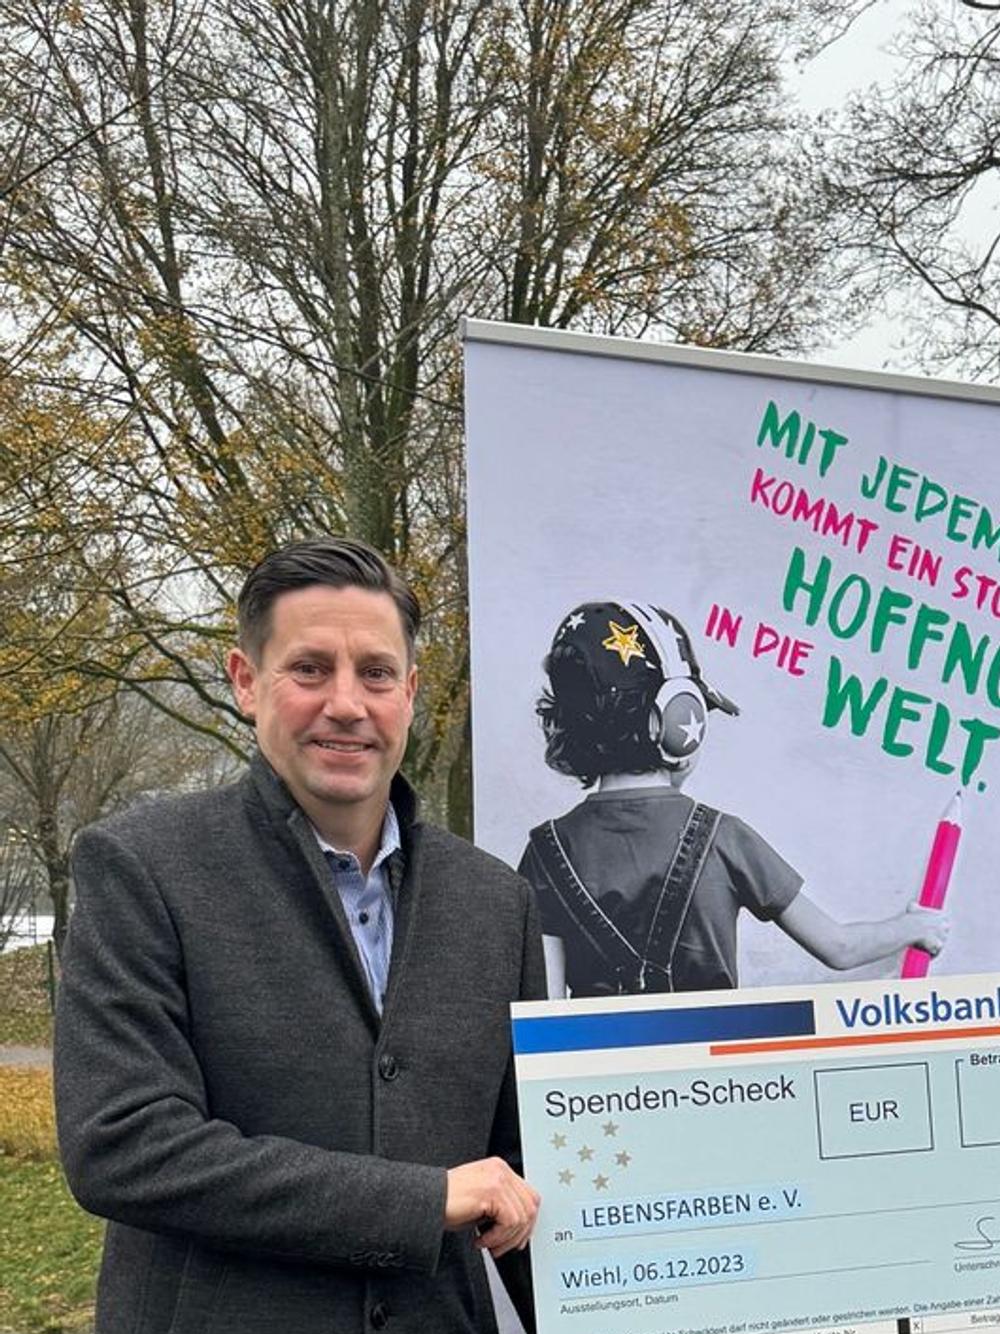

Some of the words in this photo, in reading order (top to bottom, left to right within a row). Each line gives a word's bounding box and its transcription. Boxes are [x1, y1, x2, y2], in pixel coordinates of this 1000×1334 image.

[757, 400, 848, 478] MIT
[751, 468, 879, 554] KOMMT
[887, 534, 942, 587] EIN
[705, 604, 742, 651] IN
[752, 622, 814, 676] DIE
[545, 1075, 796, 1122] Spenden-Scheck
[850, 1099, 899, 1122] EUR
[582, 1193, 751, 1228] LEBENSFARBEN
[758, 1195, 777, 1212] e.
[783, 1189, 802, 1208] V.
[554, 1228, 573, 1242] an
[561, 1266, 628, 1289] Wiehl,
[633, 1255, 745, 1282] 06.12.2023
[560, 1297, 643, 1315] Ausstellungsort,
[645, 1293, 679, 1306] Datum
[729, 1322, 746, 1333] darf
[748, 1319, 769, 1331] nicht
[811, 1312, 832, 1324] oder
[913, 1303, 928, 1312] Die
[930, 1299, 962, 1311] Angabe
[970, 1313, 1000, 1324] Betrag
